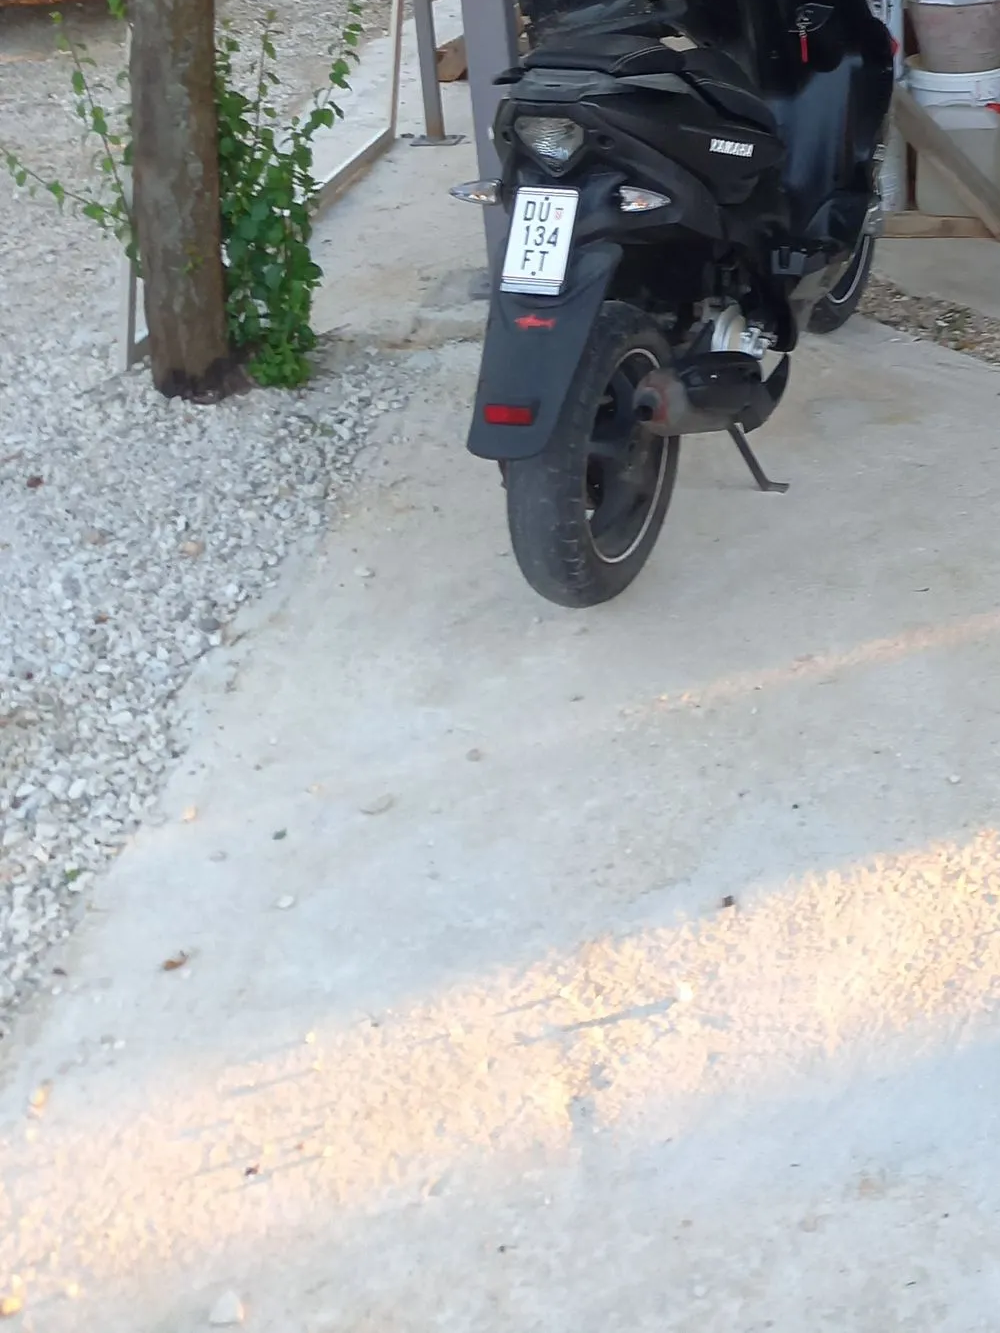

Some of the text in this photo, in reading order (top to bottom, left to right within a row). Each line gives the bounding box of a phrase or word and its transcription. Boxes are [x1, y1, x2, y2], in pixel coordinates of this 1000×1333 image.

[523, 200, 551, 222] DU
[524, 225, 559, 247] 134
[521, 250, 549, 271] FT
